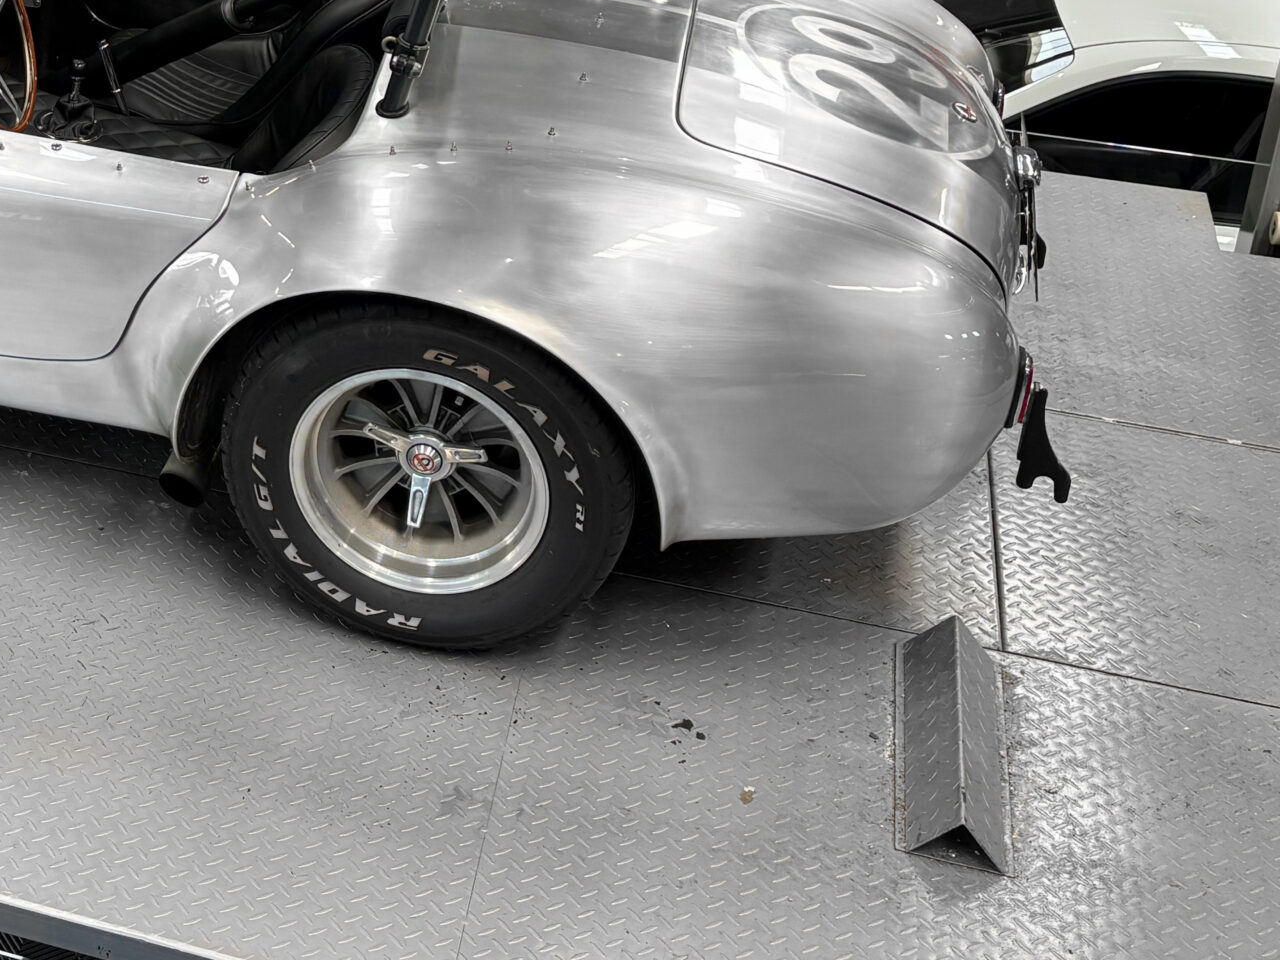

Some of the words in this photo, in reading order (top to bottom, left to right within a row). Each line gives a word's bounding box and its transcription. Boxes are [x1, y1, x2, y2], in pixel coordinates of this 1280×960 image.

[251, 436, 273, 512] G/T
[423, 349, 584, 496] GALAXY
[575, 503, 586, 533] R1
[270, 519, 423, 632] RADIAL
